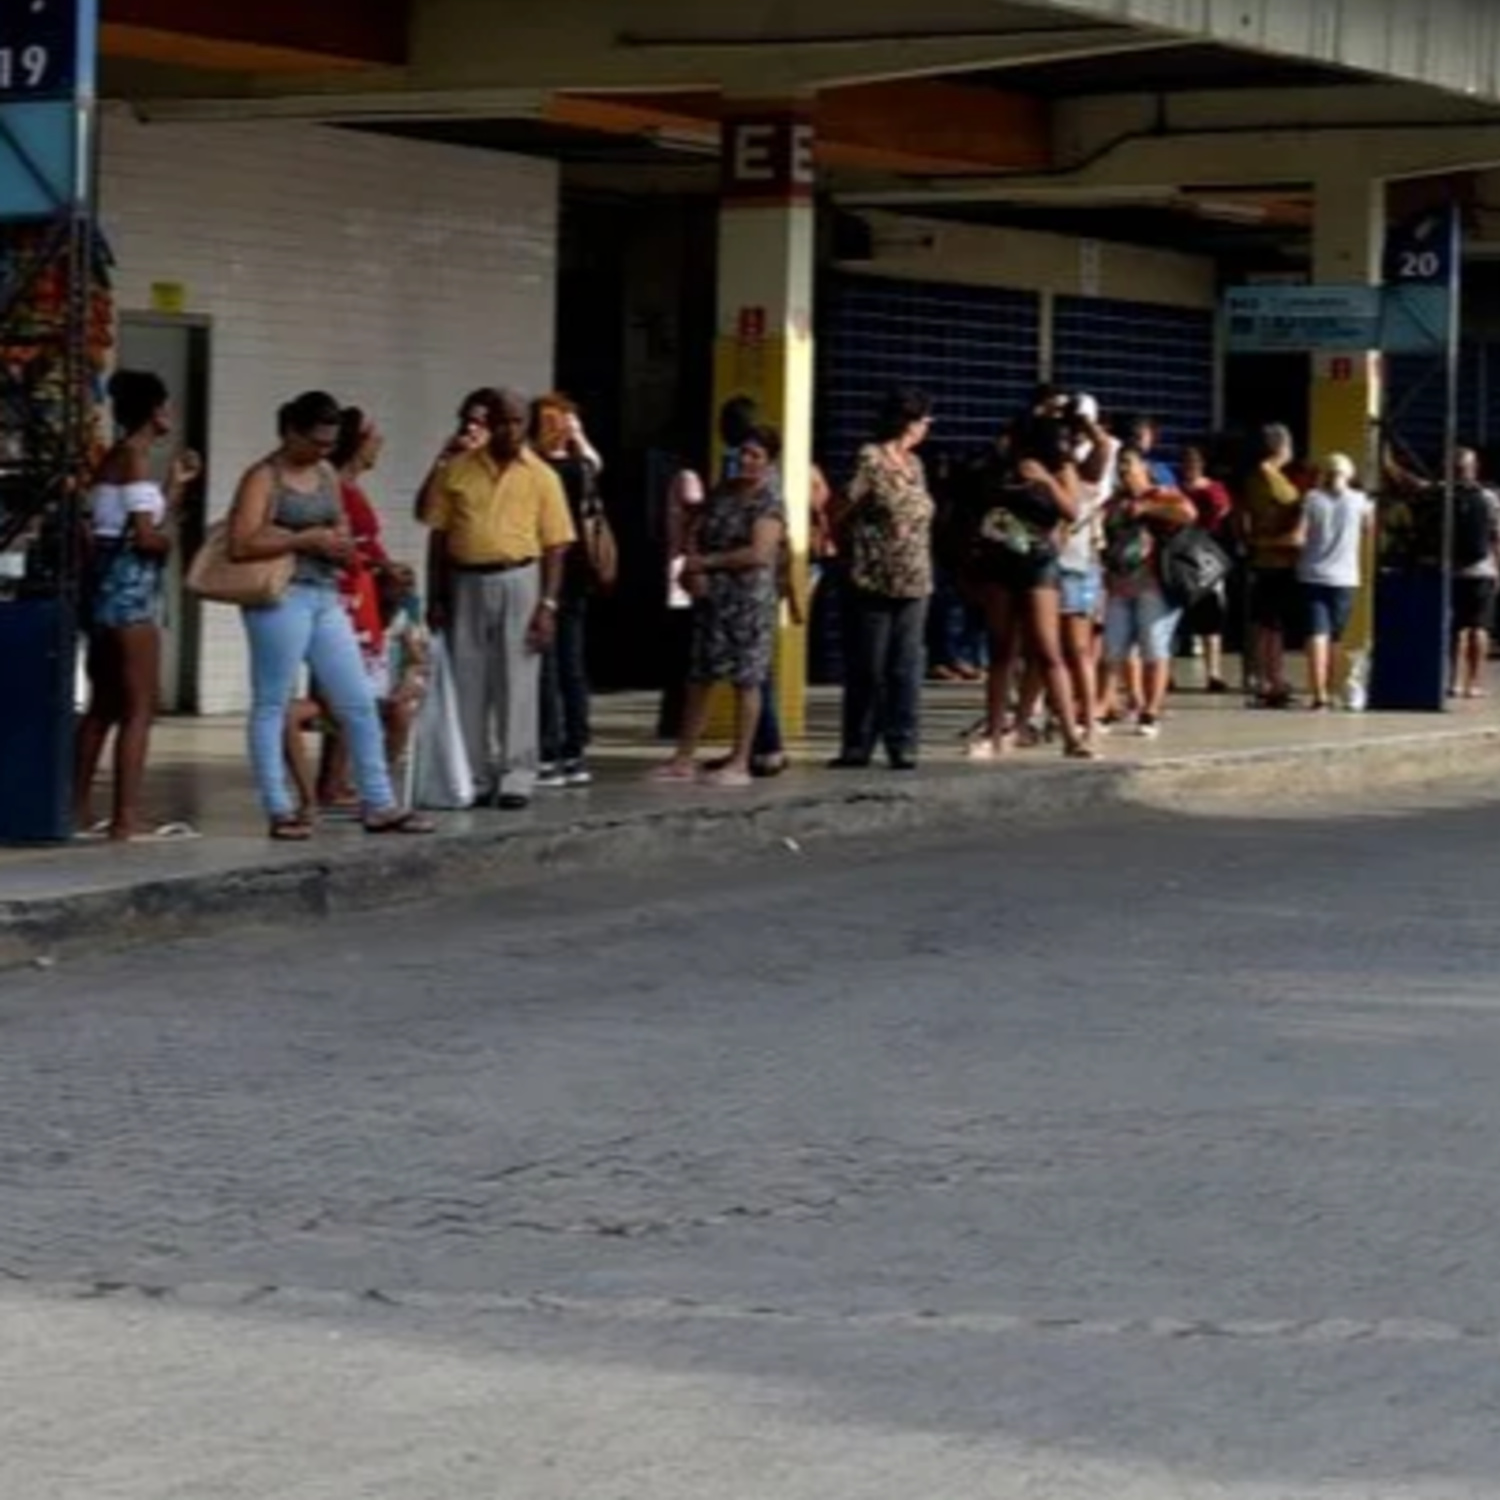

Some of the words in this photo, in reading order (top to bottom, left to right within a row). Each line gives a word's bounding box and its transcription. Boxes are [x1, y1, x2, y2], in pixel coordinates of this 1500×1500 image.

[0, 44, 47, 88] 19
[735, 124, 775, 178] E
[1399, 251, 1439, 277] 20
